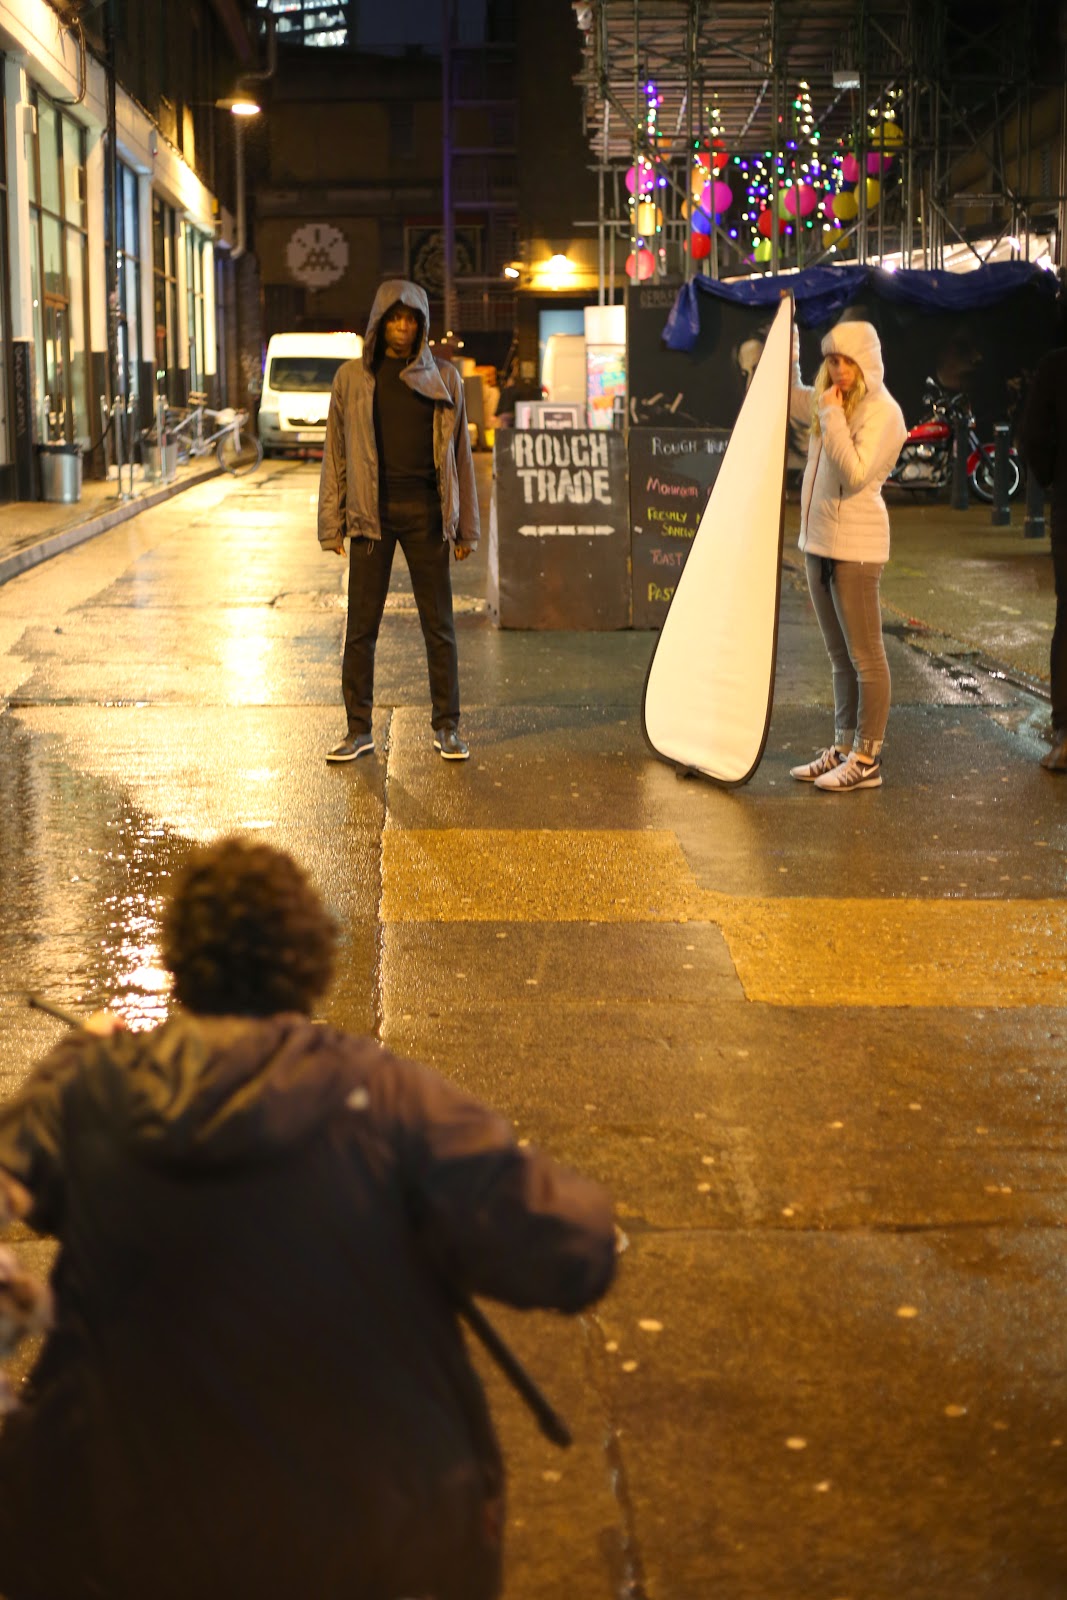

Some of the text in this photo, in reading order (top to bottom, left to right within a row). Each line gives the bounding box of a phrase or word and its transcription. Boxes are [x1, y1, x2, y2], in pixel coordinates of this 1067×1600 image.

[513, 433, 608, 467] ROUGH
[517, 469, 612, 504] TRADE
[649, 548, 684, 566] TOAST
